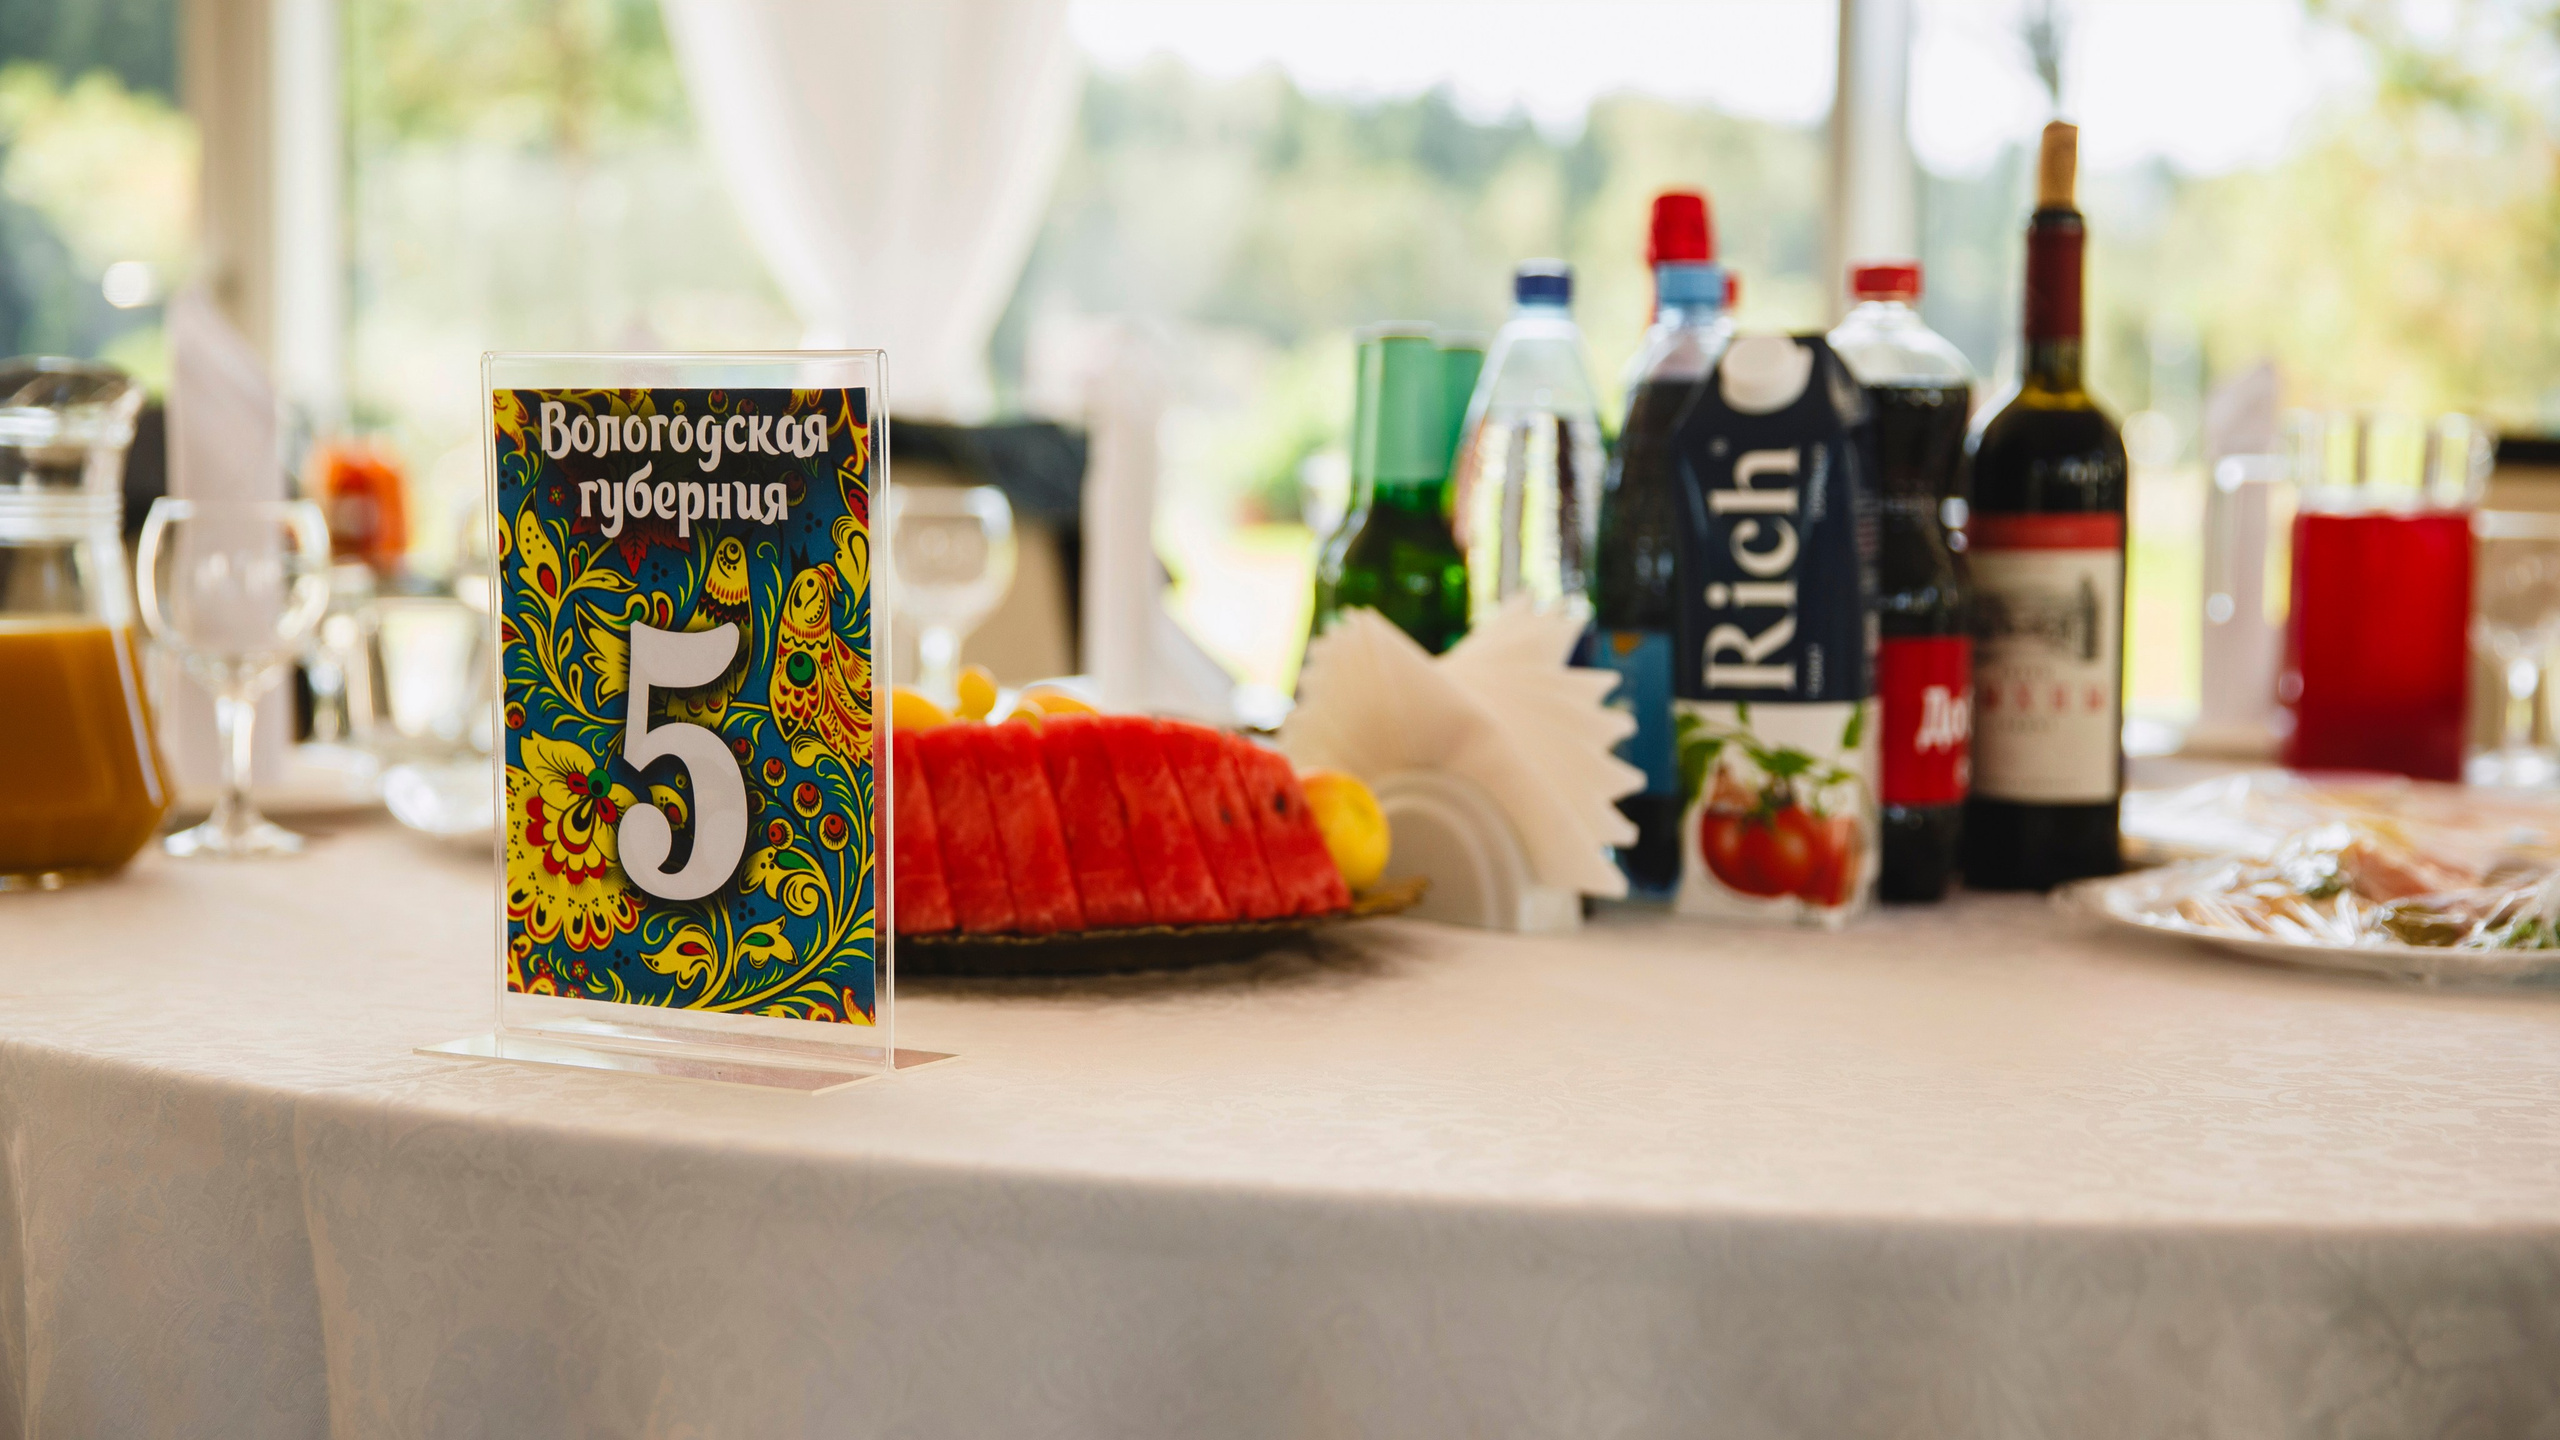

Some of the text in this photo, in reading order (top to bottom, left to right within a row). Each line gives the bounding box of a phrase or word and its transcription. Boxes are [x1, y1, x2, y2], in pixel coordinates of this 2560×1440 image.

[540, 401, 829, 472] Вологодская
[578, 460, 788, 538] губерния
[1703, 446, 1800, 690] Rich
[1915, 683, 1974, 753] До
[617, 619, 748, 900] 5
